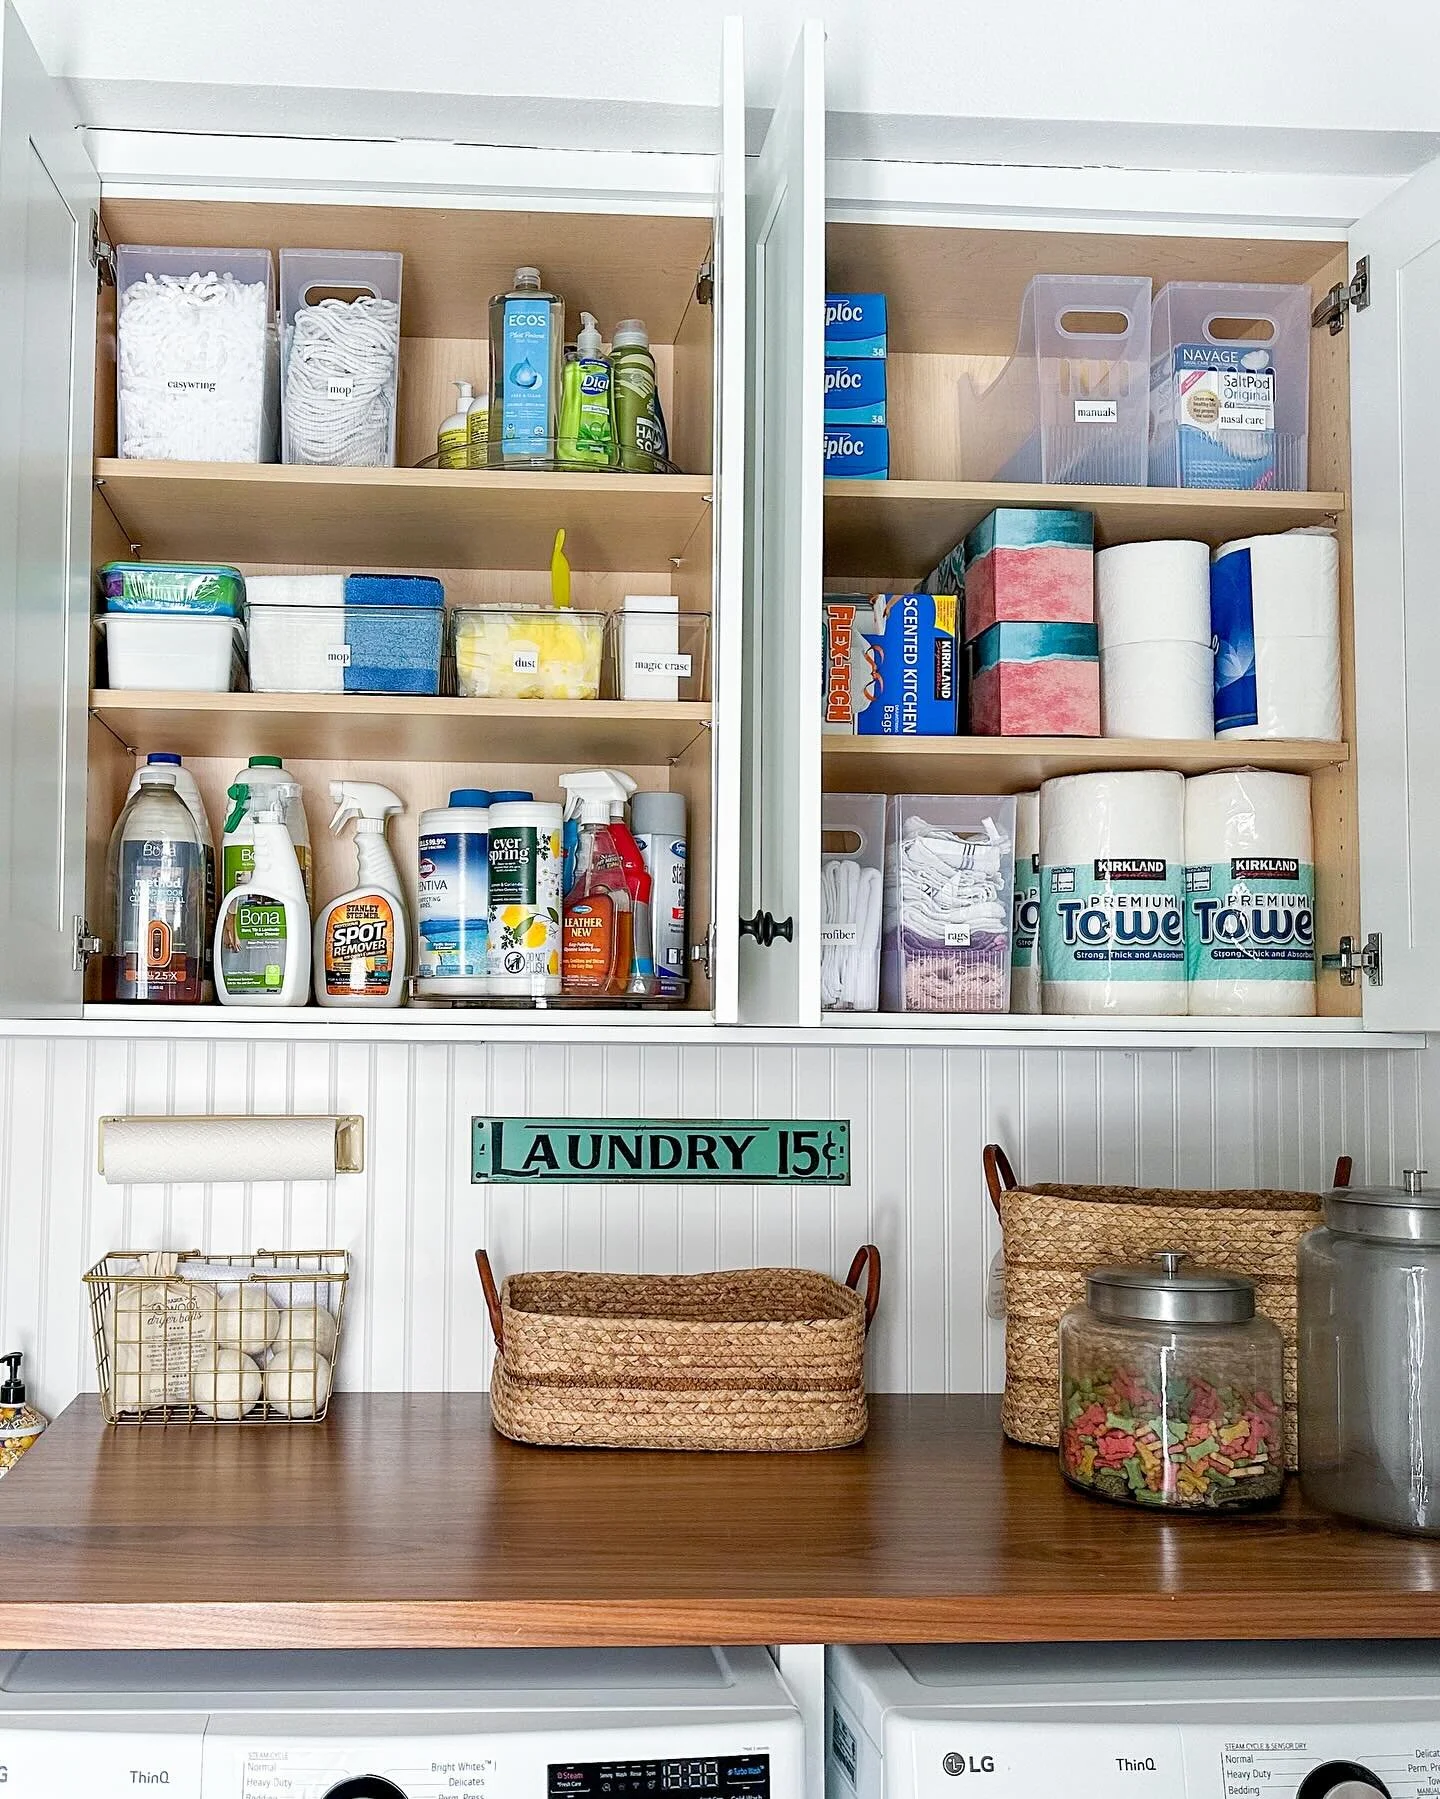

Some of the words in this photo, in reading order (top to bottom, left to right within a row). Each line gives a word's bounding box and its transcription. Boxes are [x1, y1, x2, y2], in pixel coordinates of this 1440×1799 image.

[509, 314, 546, 327] ECOS
[872, 349, 885, 357] 38
[1183, 348, 1239, 363] NAVAGE
[167, 378, 217, 392] easywring
[583, 374, 610, 389] Dial
[1223, 374, 1271, 390] SaltPod
[329, 384, 352, 397] mop
[1223, 387, 1271, 403] Original
[1077, 406, 1117, 417] manuals
[1224, 401, 1236, 409] 60
[871, 416, 884, 424] 38
[1220, 414, 1243, 424] nasal
[1245, 416, 1265, 425] care
[824, 436, 864, 459] iploc
[903, 597, 918, 665] SCENTED
[327, 652, 350, 663] mop
[514, 656, 536, 669] dust
[826, 605, 856, 722] FLEX-TECH
[634, 660, 662, 672] magic
[941, 640, 951, 699] KIRKLAND
[902, 668, 918, 734] KITCHEN
[881, 705, 895, 733] Bags
[493, 837, 522, 850] ever
[143, 844, 177, 857] Boa
[488, 847, 530, 865] spring
[1097, 861, 1164, 872] KIRKLAND
[1235, 860, 1297, 871] KIRKLAND
[418, 880, 448, 892] ENTIVA
[1091, 896, 1175, 907] PREMIUM
[1227, 895, 1306, 907] PREMIUM
[346, 904, 380, 913] STANLEY
[240, 909, 281, 925] Bona
[564, 917, 603, 928] LEATHER
[1193, 901, 1313, 942] Towe
[333, 921, 387, 947] SPOT
[571, 927, 592, 938] NEW
[821, 930, 857, 941] rofiber
[947, 931, 969, 944] rags
[333, 939, 387, 957] REMOVER
[1213, 950, 1245, 959] Strong,
[1271, 950, 1286, 958] and
[526, 953, 535, 962] DO
[535, 953, 545, 962] NOT
[1076, 951, 1108, 960] Strong,
[1109, 951, 1133, 959] Thick
[1134, 951, 1150, 959] and
[526, 963, 546, 975] FLUSH
[491, 1121, 756, 1178] LAUNDRY
[778, 1130, 837, 1177] 15¢
[147, 1314, 178, 1328] dryer
[178, 1311, 203, 1324] balls
[1224, 1742, 1246, 1750] STEAM
[1246, 1742, 1263, 1750] CYCLE
[1271, 1742, 1294, 1750] SENSOR
[1225, 1754, 1254, 1764] Normal
[1415, 1749, 1440, 1759] Delicat
[247, 1762, 277, 1772] Normal
[431, 1762, 456, 1774] Bright
[969, 1755, 996, 1773] LG
[1115, 1757, 1157, 1772] ThinQ
[1407, 1763, 1429, 1773] Perm.
[1430, 1762, 1440, 1771] Pre
[0, 1765, 8, 1782] G
[129, 1770, 170, 1785] ThinQ
[562, 1771, 584, 1780] Steam
[1226, 1769, 1251, 1781] Heavy
[1252, 1768, 1272, 1781] Duty
[246, 1778, 271, 1789] Heavy
[273, 1777, 293, 1790] Duty
[448, 1777, 485, 1787] Delicates
[1228, 1785, 1260, 1797] Bedding
